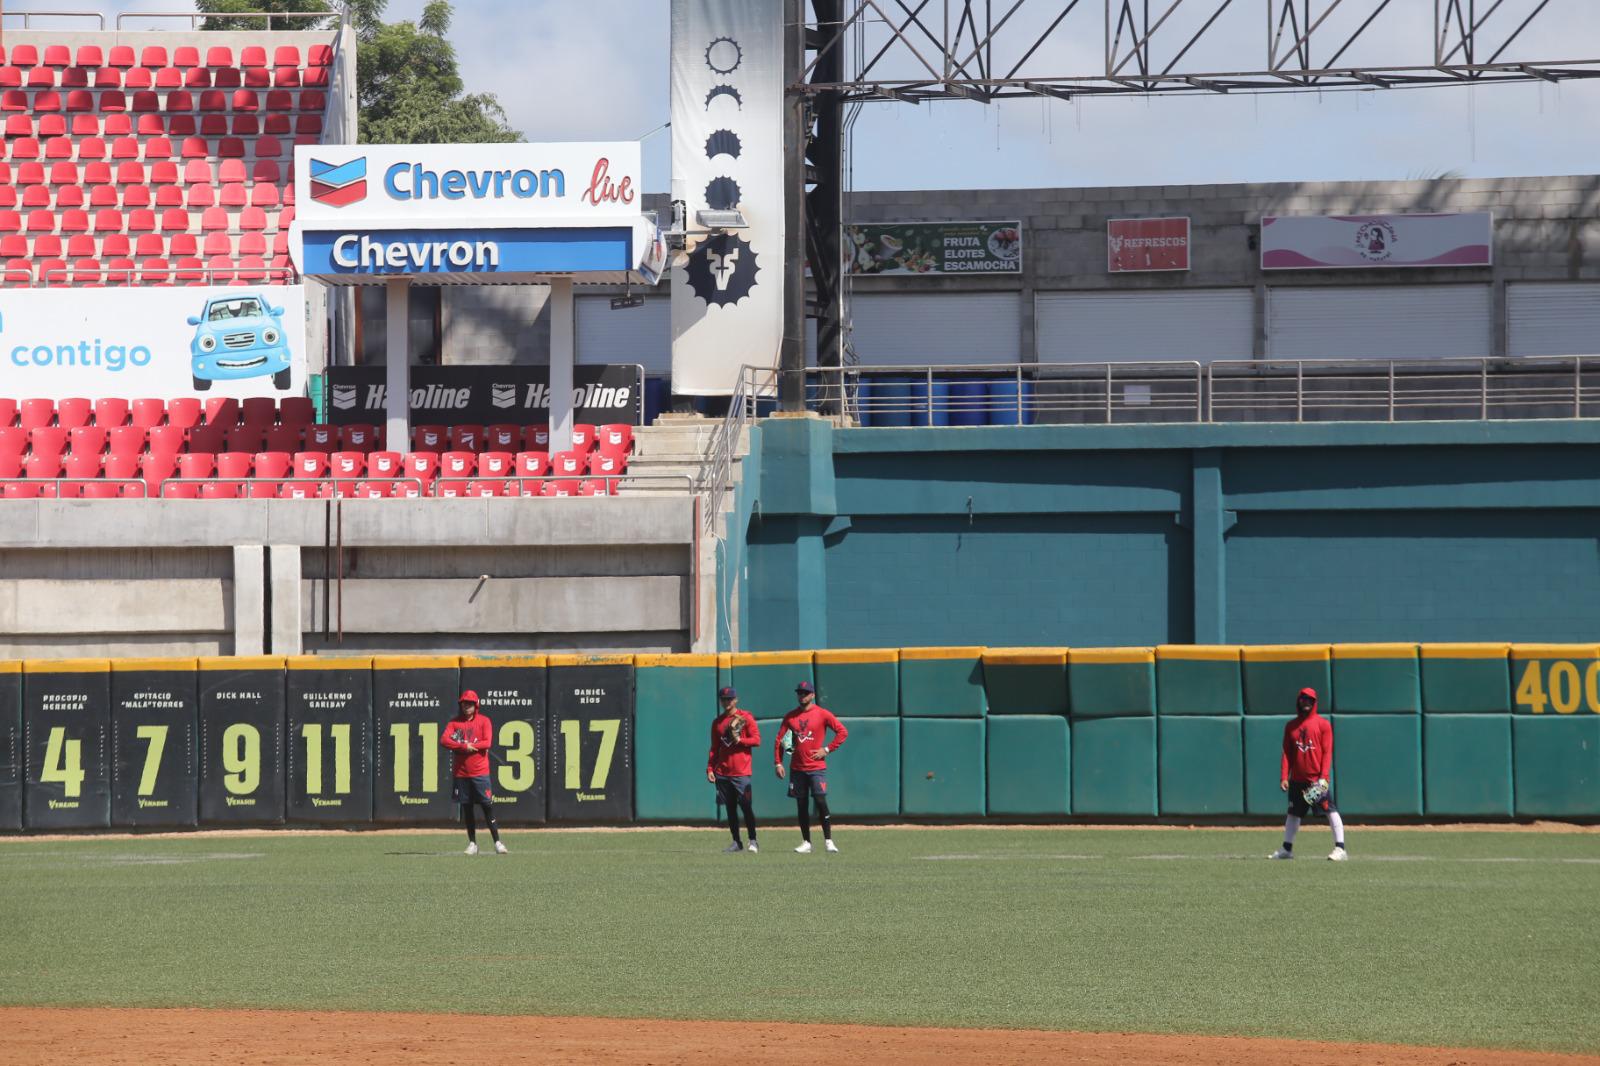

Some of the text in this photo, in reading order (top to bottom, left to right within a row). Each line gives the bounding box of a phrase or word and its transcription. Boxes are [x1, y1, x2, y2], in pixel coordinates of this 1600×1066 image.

[385, 158, 634, 206] Chevron live
[944, 237, 981, 247] FRUTA
[1124, 237, 1186, 248] REFRESCOS
[333, 234, 498, 267] Chevron
[945, 249, 986, 259] ELOTES
[944, 261, 1016, 271] ESCAMOCHA
[11, 338, 152, 373] contigo
[365, 384, 471, 409] Holine
[524, 383, 630, 409] Haoline
[133, 692, 171, 700] EPITACIO
[302, 692, 353, 701] GUILLERMO
[397, 691, 429, 699] DANIEL
[487, 690, 518, 698] FELIPE
[574, 688, 606, 696] DANIEL
[42, 694, 88, 702] PROCOPIO
[479, 698, 533, 706] ONTEMAYOR
[42, 702, 84, 710] HERRERA
[309, 701, 346, 709] GARIBAY
[222, 723, 261, 795] 9
[302, 723, 350, 794] 11
[390, 722, 439, 793] 11
[560, 719, 621, 790] 17
[40, 726, 86, 797] 4
[136, 725, 169, 796] 7
